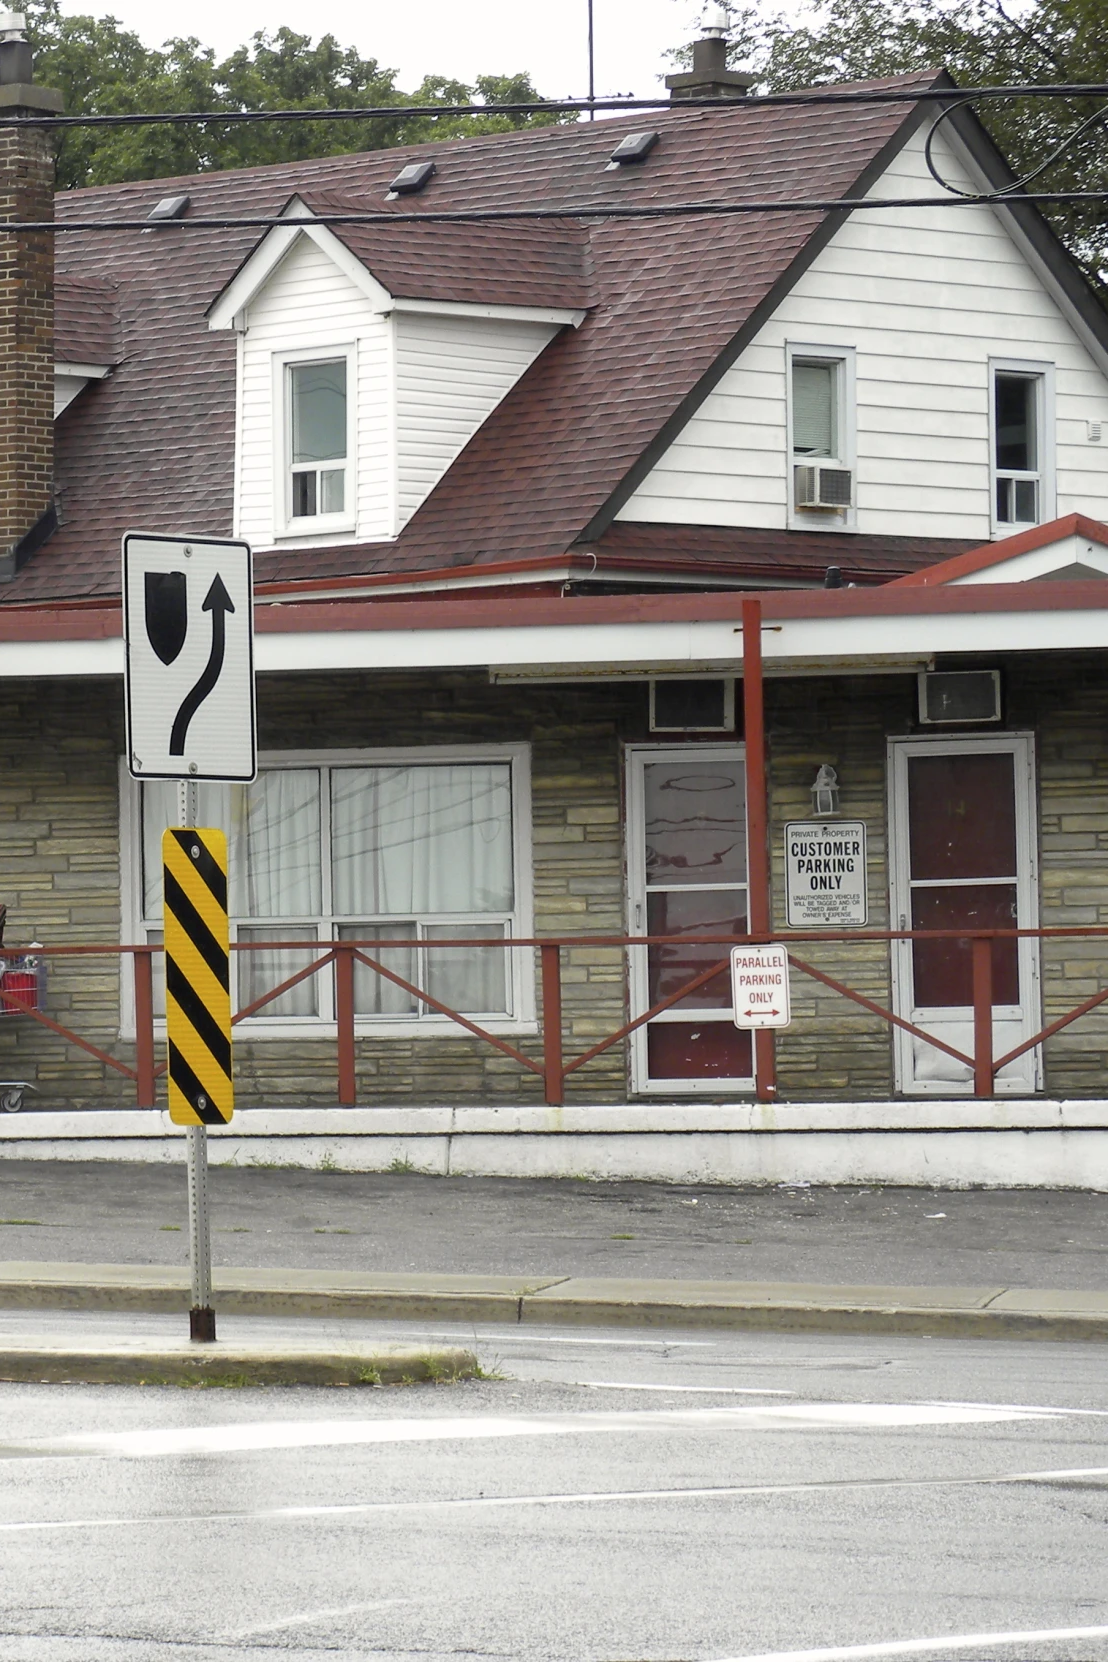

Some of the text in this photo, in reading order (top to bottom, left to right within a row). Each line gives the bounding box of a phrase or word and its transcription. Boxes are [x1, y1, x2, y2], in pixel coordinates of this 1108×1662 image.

[791, 829, 860, 838] PRIVATE PROPERTY
[791, 841, 860, 857] CUSTOMER
[797, 858, 855, 874] PARKING
[810, 875, 842, 890] ONLY
[735, 956, 784, 968] PARALLEL
[739, 973, 782, 986] PARKING
[749, 992, 774, 1004] ONLY
